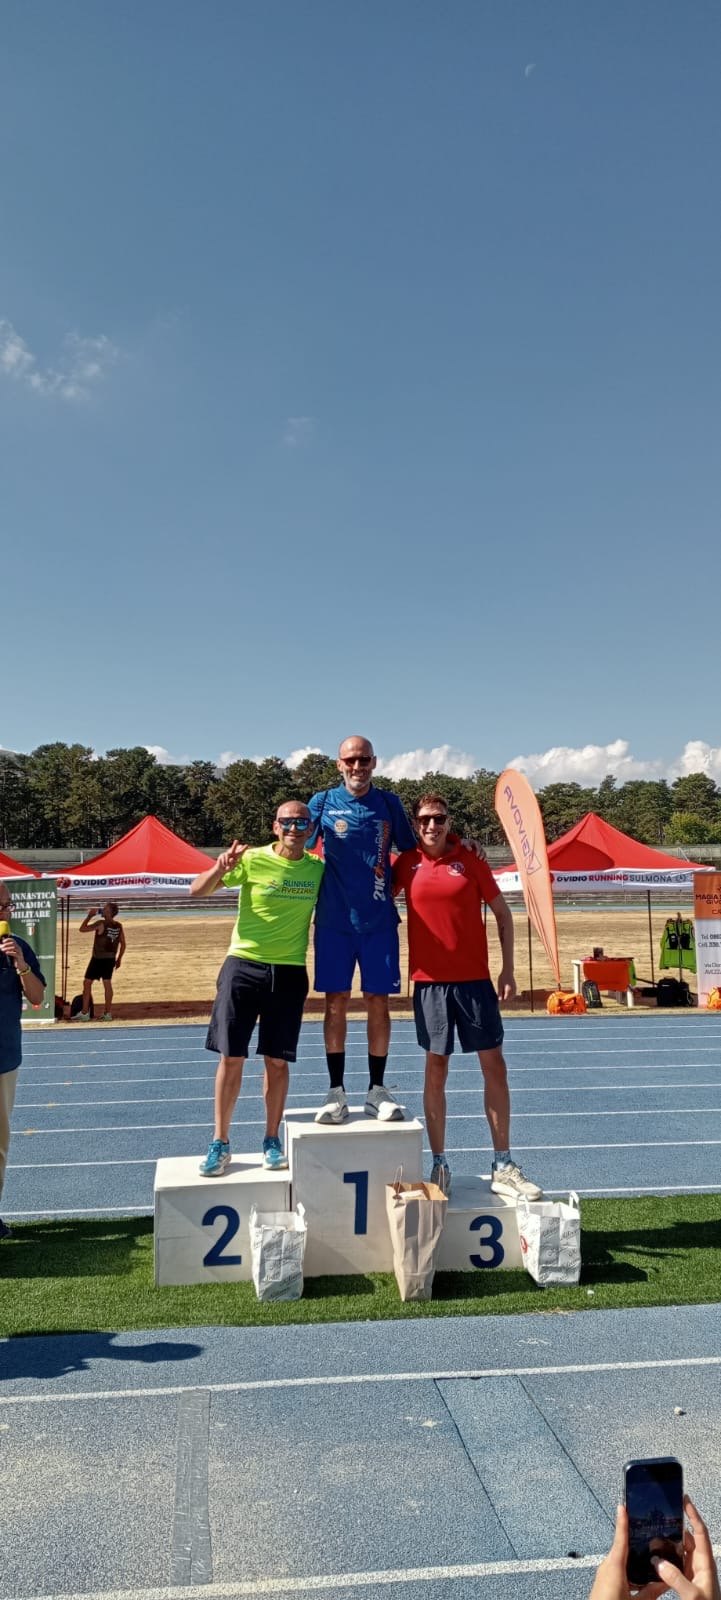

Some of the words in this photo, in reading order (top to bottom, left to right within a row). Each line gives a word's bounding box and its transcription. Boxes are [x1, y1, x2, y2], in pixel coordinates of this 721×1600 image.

[108, 877, 151, 886] RUNNING
[152, 876, 191, 885] SULMON
[588, 874, 629, 882] RUNNING
[630, 874, 672, 882] SULMONA
[11, 891, 56, 900] INNASTICA
[16, 900, 51, 910] INAMICA
[11, 910, 51, 919] MILITARE
[343, 1171, 368, 1235] 1
[201, 1205, 242, 1267] 2
[469, 1215, 505, 1269] 3
